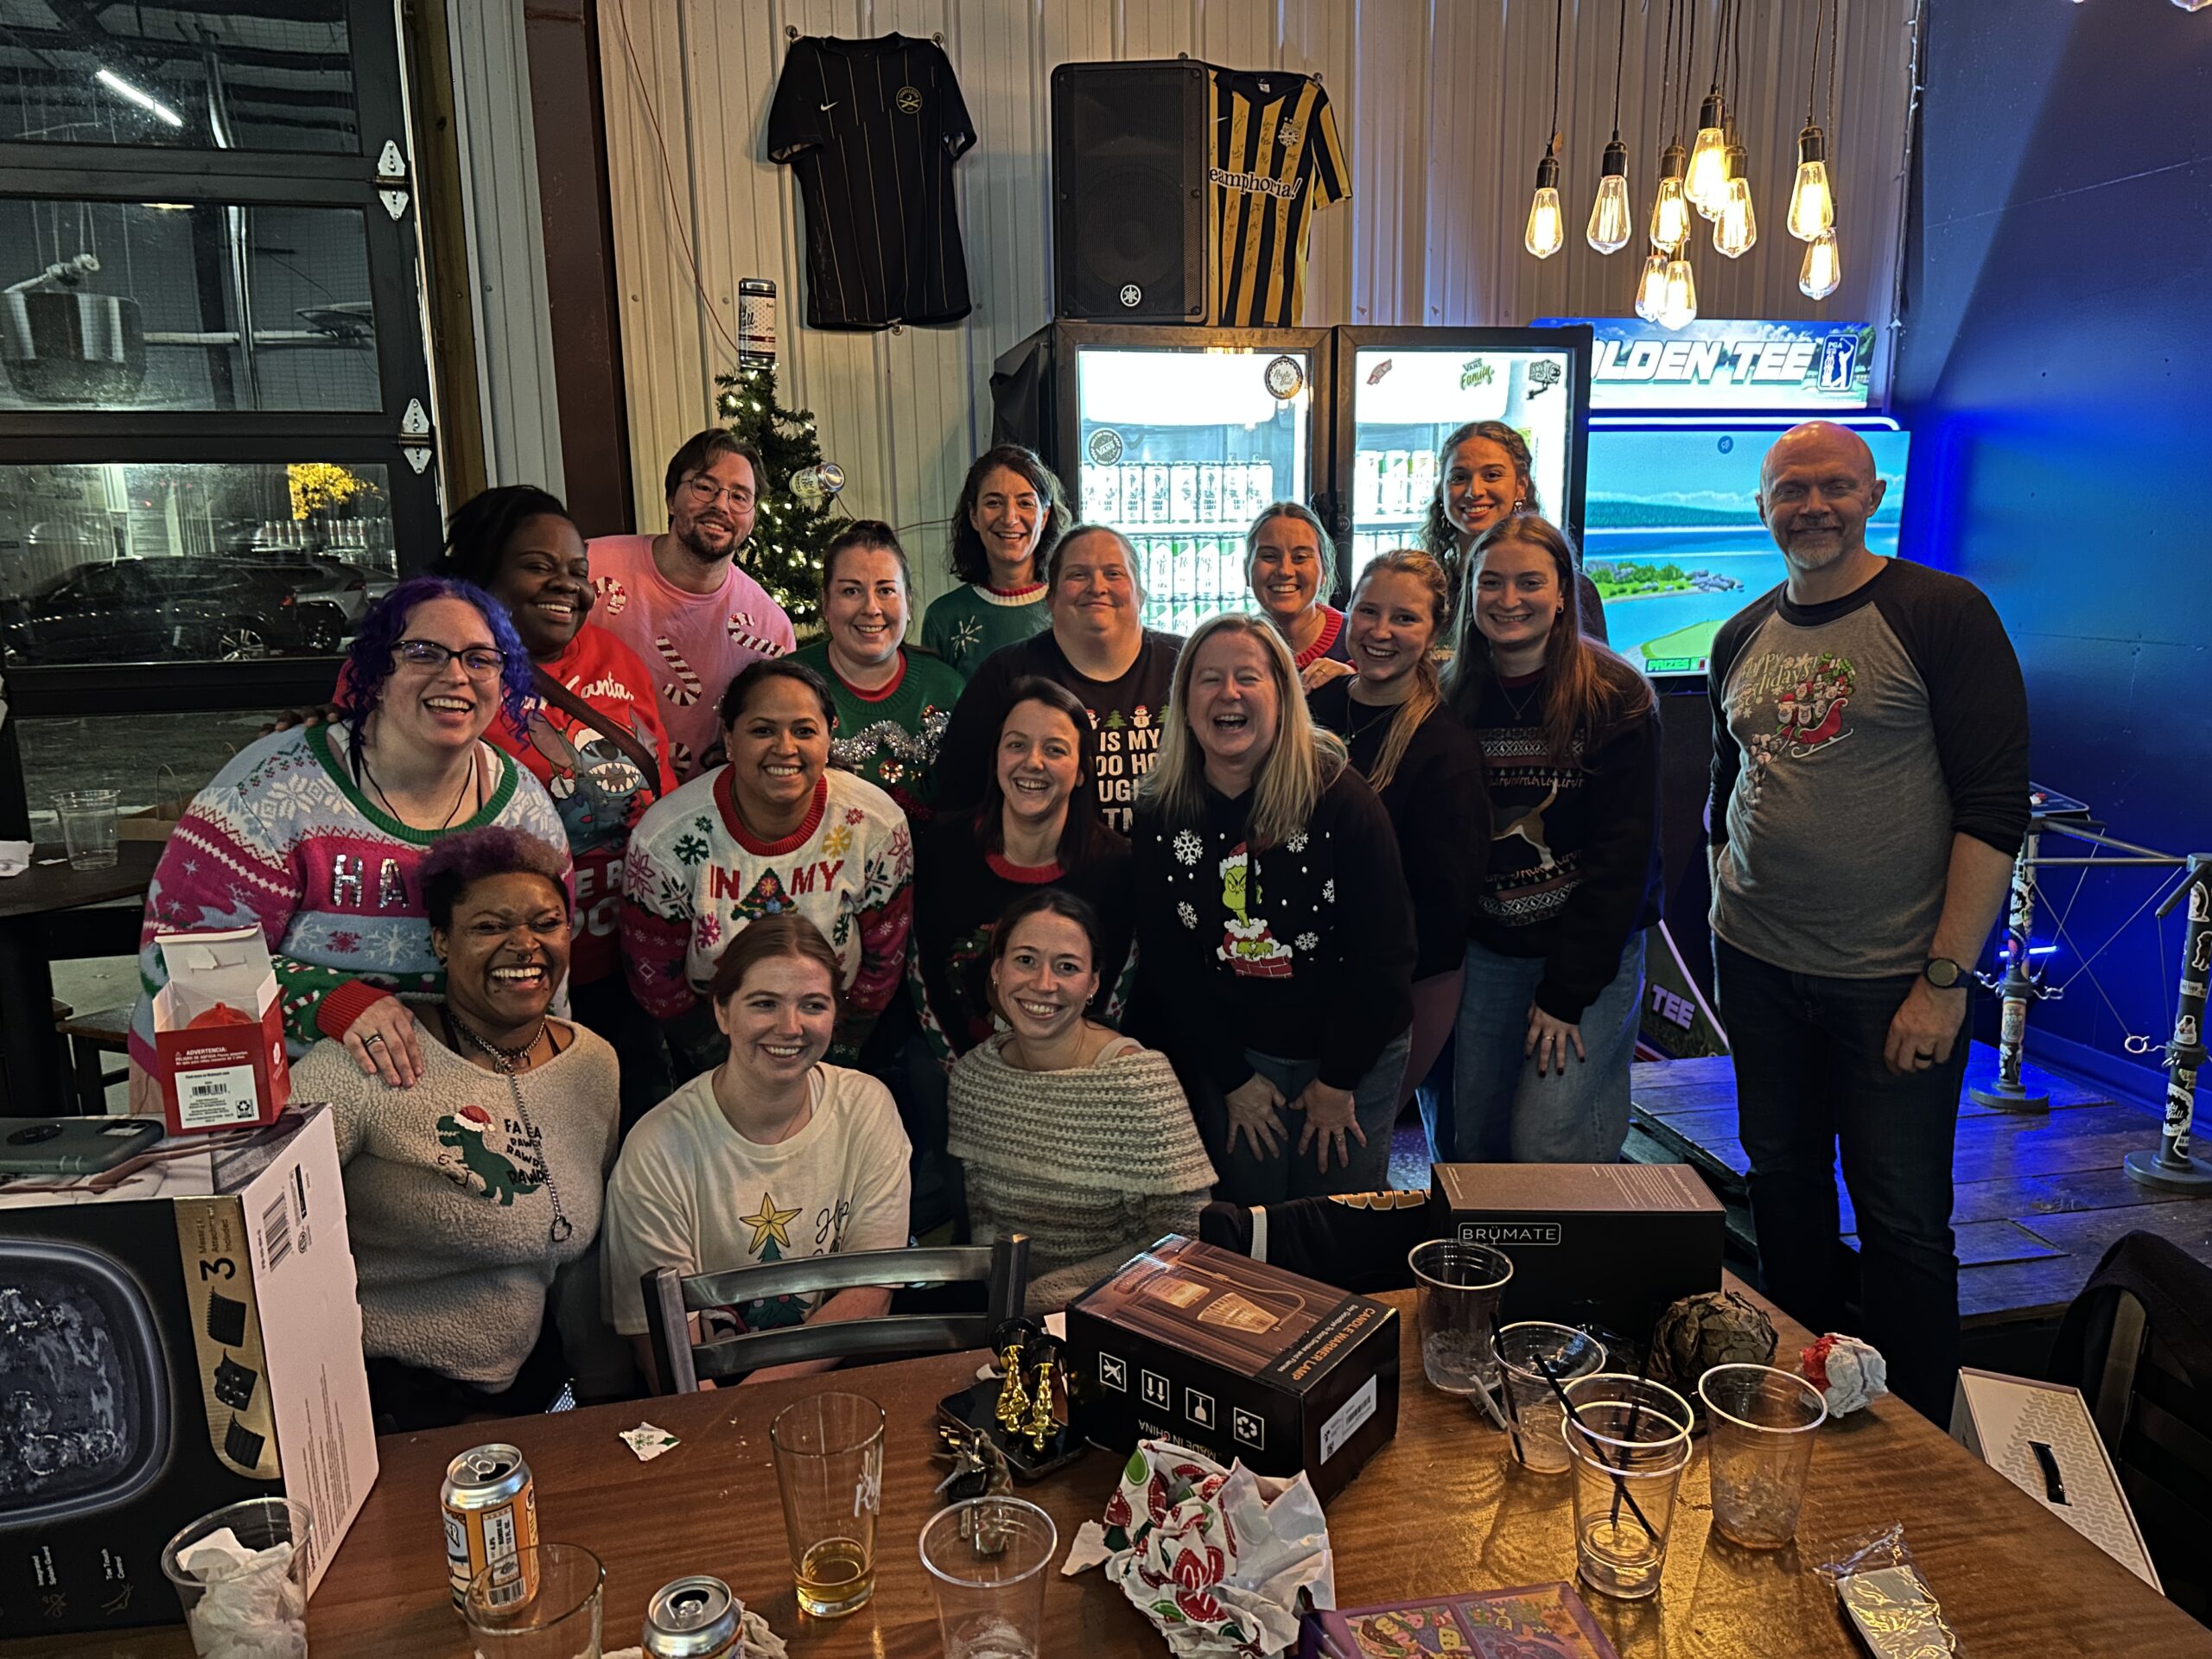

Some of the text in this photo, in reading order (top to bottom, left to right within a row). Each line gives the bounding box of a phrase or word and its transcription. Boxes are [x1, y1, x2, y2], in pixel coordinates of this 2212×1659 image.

[1731, 341, 1816, 383] TEE
[1100, 728, 1160, 752] IS MY
[710, 860, 844, 900] IN MY
[1652, 984, 1695, 1030] TEE
[504, 1119, 522, 1135] FA
[221, 1218, 232, 1252] Included
[1463, 1226, 1556, 1244] BRÜMATE
[200, 1258, 236, 1281] 3
[1292, 1307, 1376, 1381] CANDLE WARMER LAMP
[1139, 1419, 1170, 1441] CHINA
[1173, 1434, 1183, 1446] IN
[41, 1546, 52, 1565] Guard
[101, 1548, 111, 1568] Touch
[114, 1556, 124, 1579] Control
